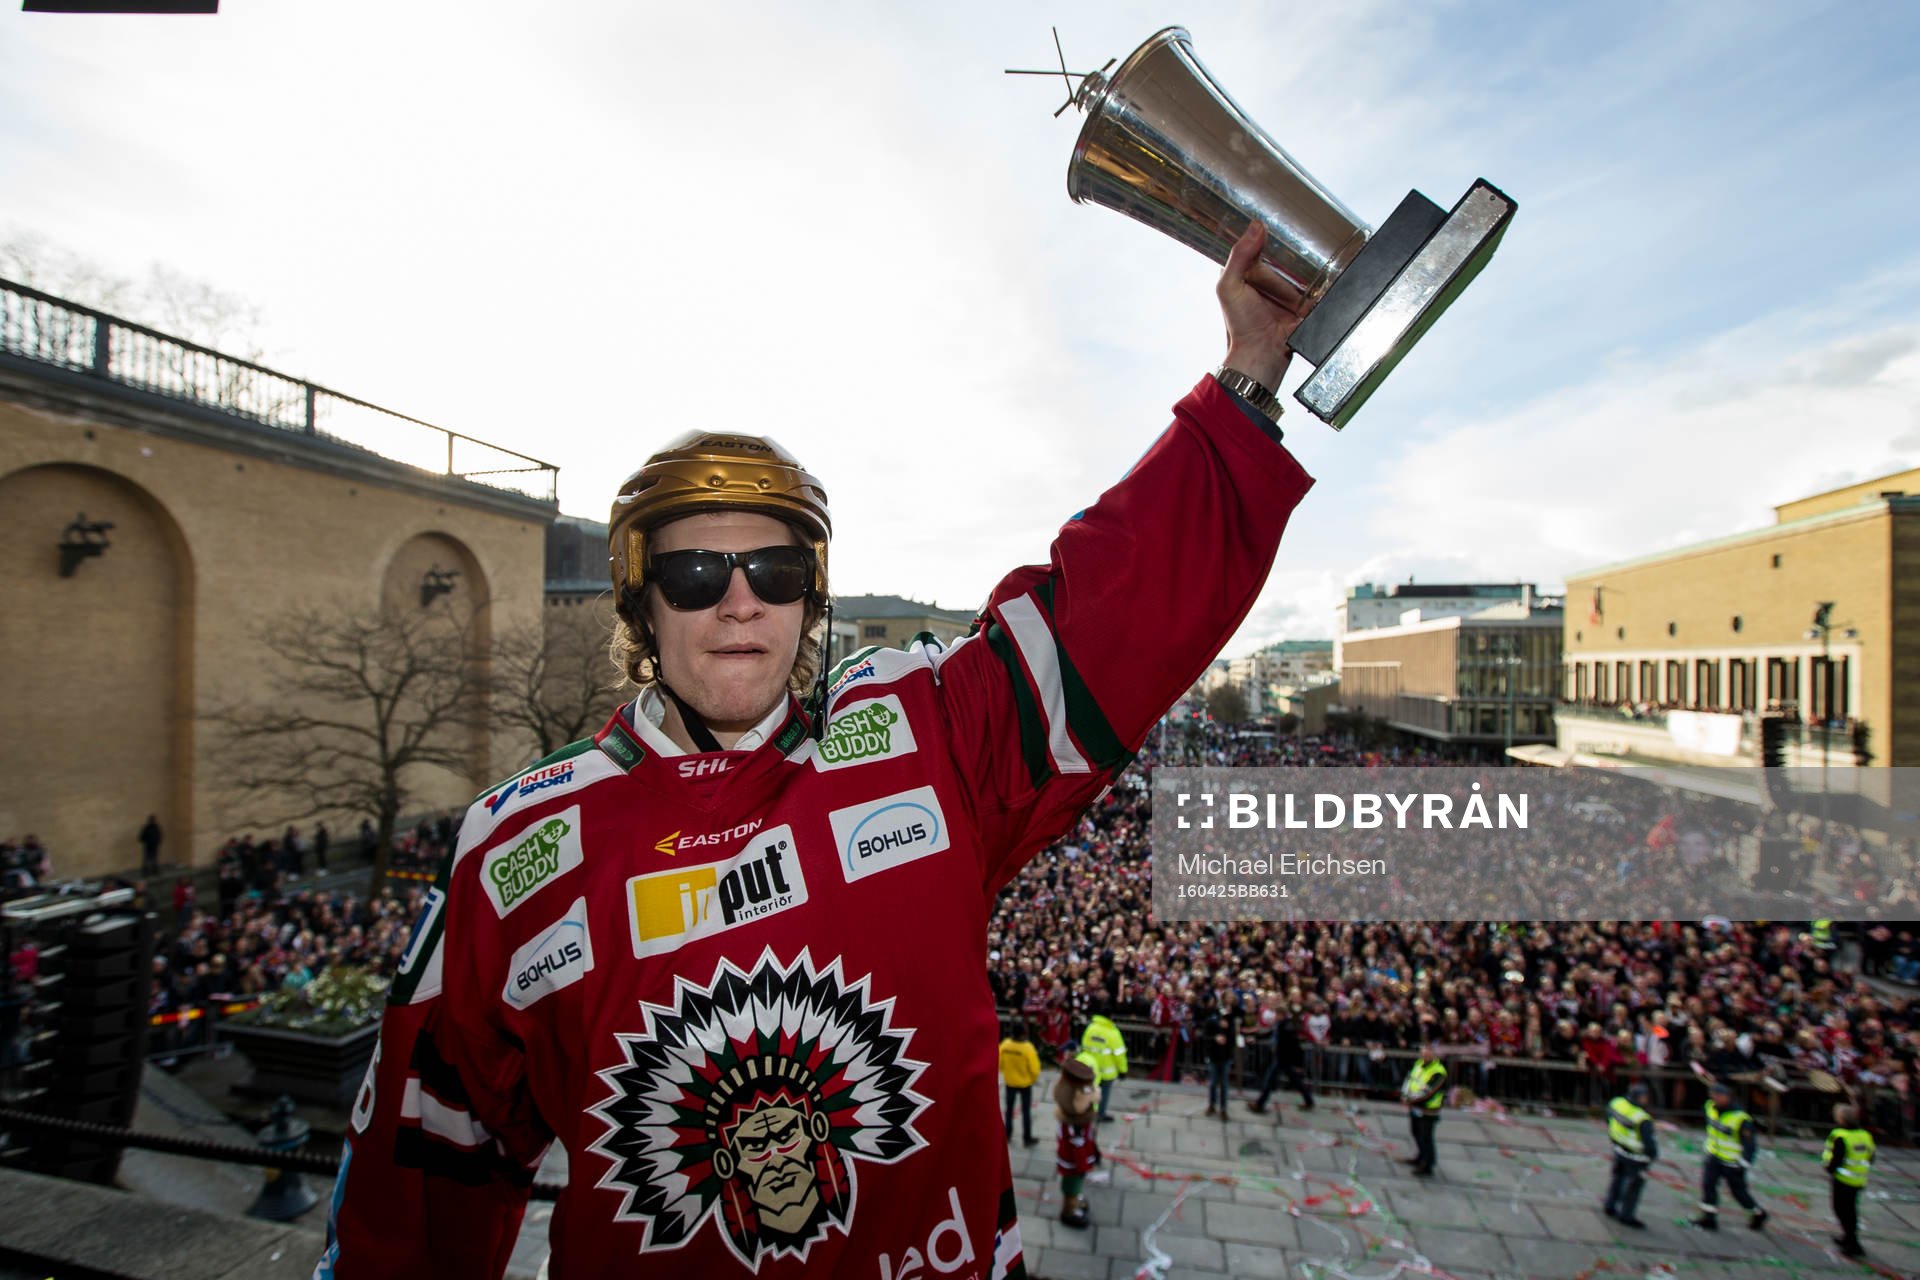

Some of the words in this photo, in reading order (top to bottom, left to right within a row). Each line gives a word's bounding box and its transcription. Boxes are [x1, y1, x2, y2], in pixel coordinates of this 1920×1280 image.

[700, 440, 773, 453] EASTON
[829, 713, 872, 740] ASH
[823, 730, 888, 760] BUDDY
[520, 761, 574, 787] INTER
[678, 758, 736, 778] SHL
[519, 770, 574, 797] SPORT
[677, 818, 763, 850] EASTON
[857, 823, 927, 859] BOHUS
[494, 836, 542, 885] CASH
[502, 848, 557, 904] BUDDY
[738, 895, 793, 921] interiör
[516, 941, 582, 991] BOHUS
